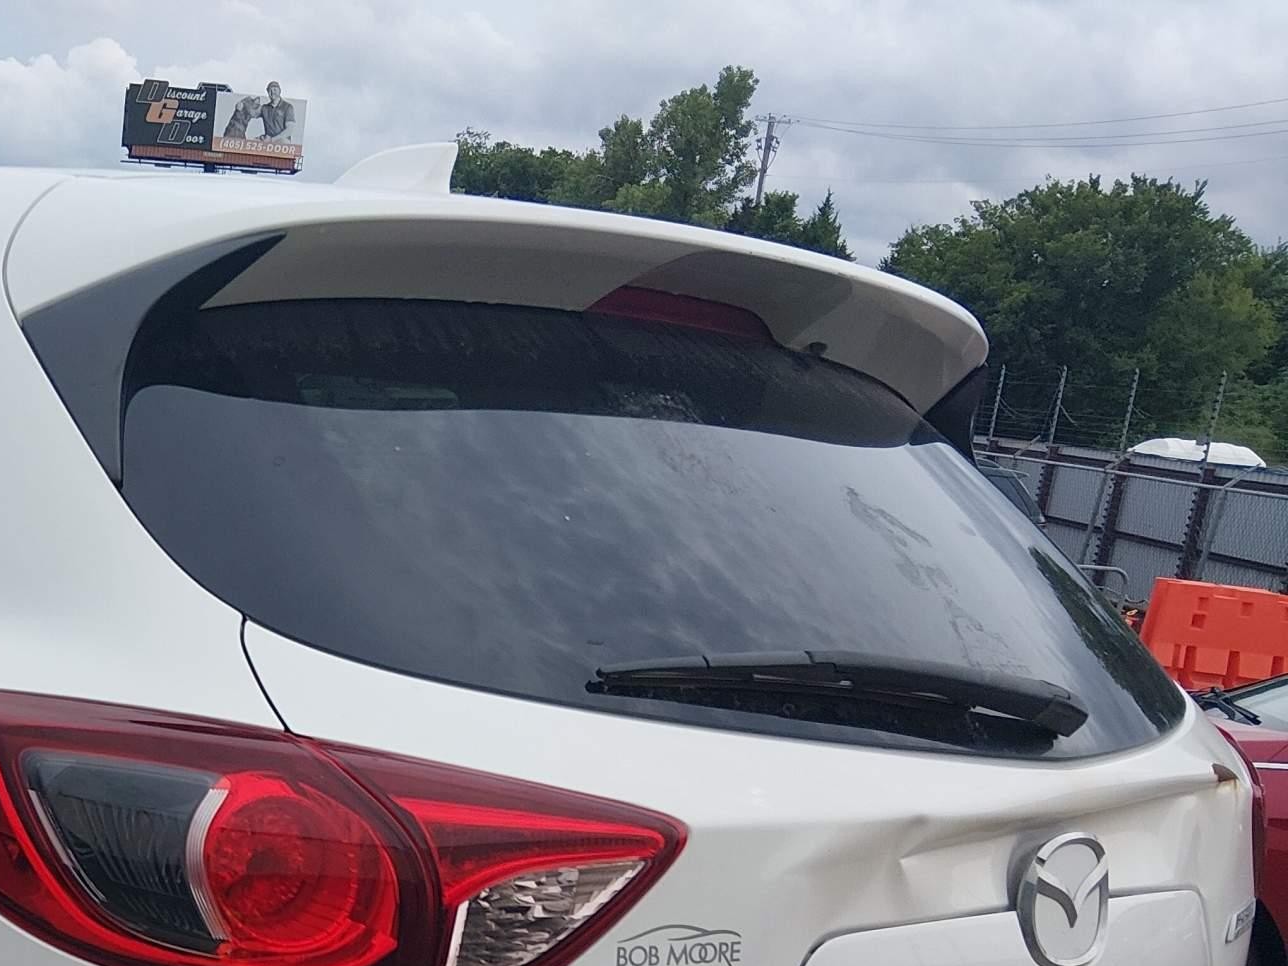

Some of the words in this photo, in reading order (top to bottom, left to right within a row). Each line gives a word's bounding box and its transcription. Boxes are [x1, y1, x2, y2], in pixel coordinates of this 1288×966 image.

[136, 79, 206, 103] Discount
[146, 99, 207, 123] Garage
[157, 120, 204, 144] Door
[219, 139, 244, 151] (405)
[246, 141, 296, 155] 525-DOOR
[616, 945, 660, 966] BOB
